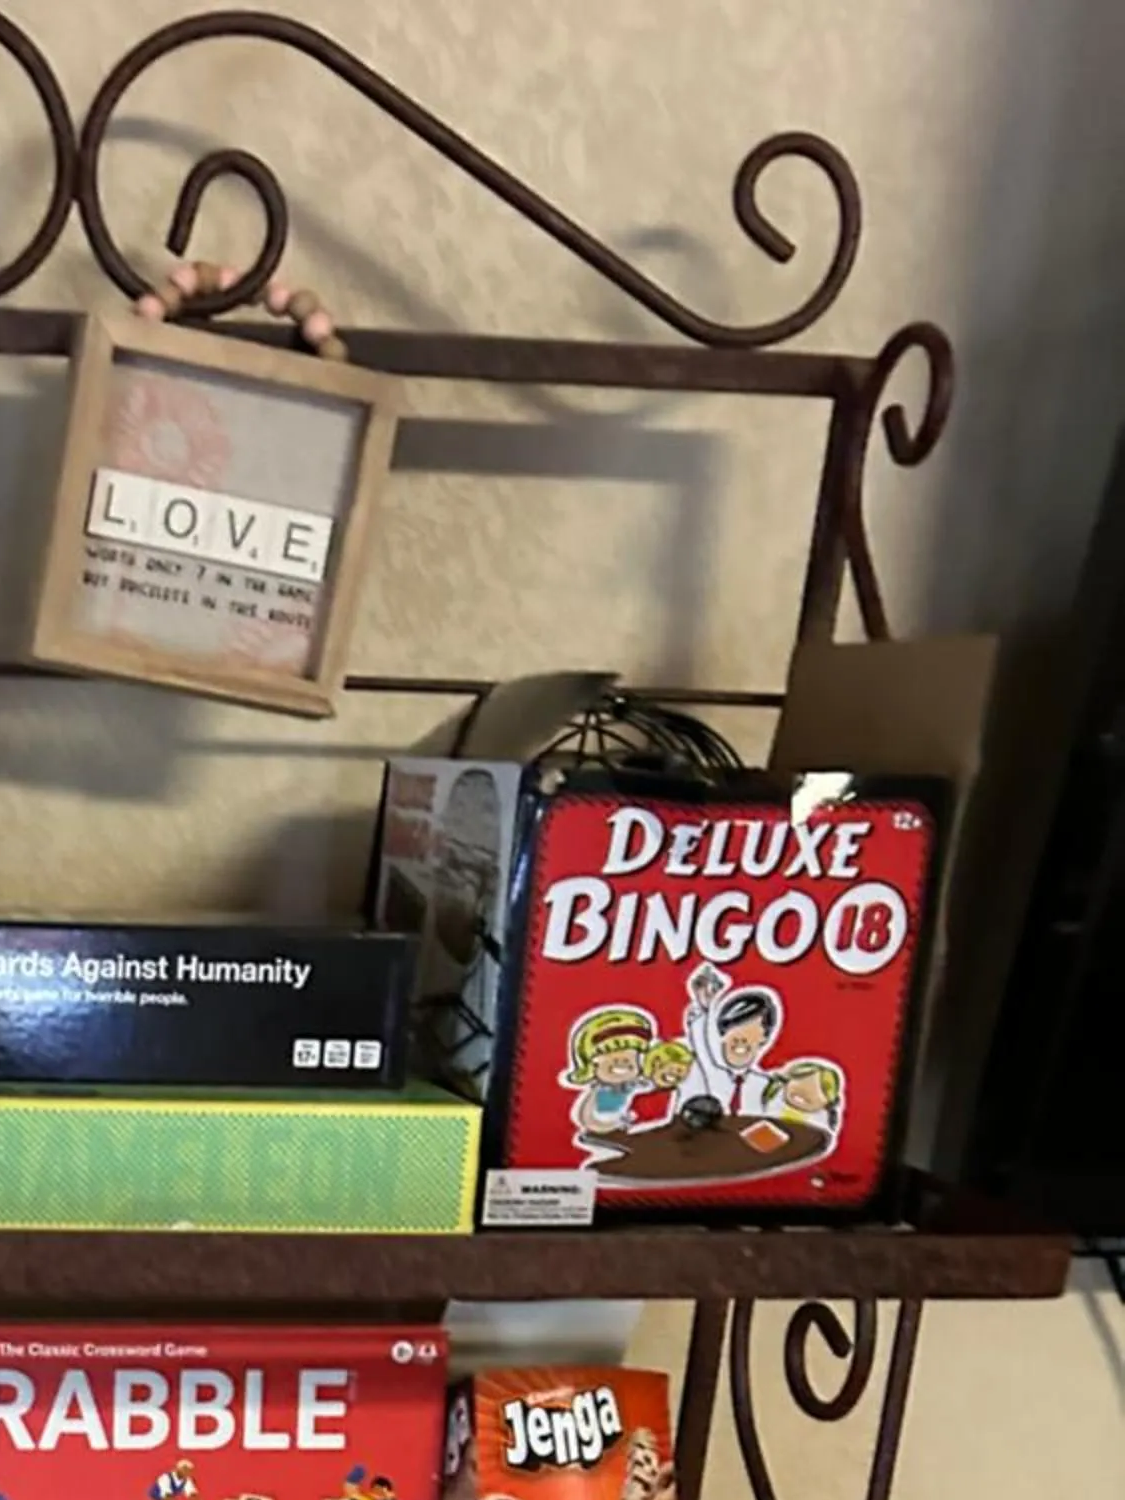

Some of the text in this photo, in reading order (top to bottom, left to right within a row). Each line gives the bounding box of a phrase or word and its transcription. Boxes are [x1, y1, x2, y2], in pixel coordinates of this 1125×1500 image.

[601, 807, 873, 879] DELUXE
[542, 876, 894, 964] BINGO 18
[62, 951, 169, 984] Against
[177, 954, 311, 988] Humanity
[504, 1385, 623, 1466] Jenga
